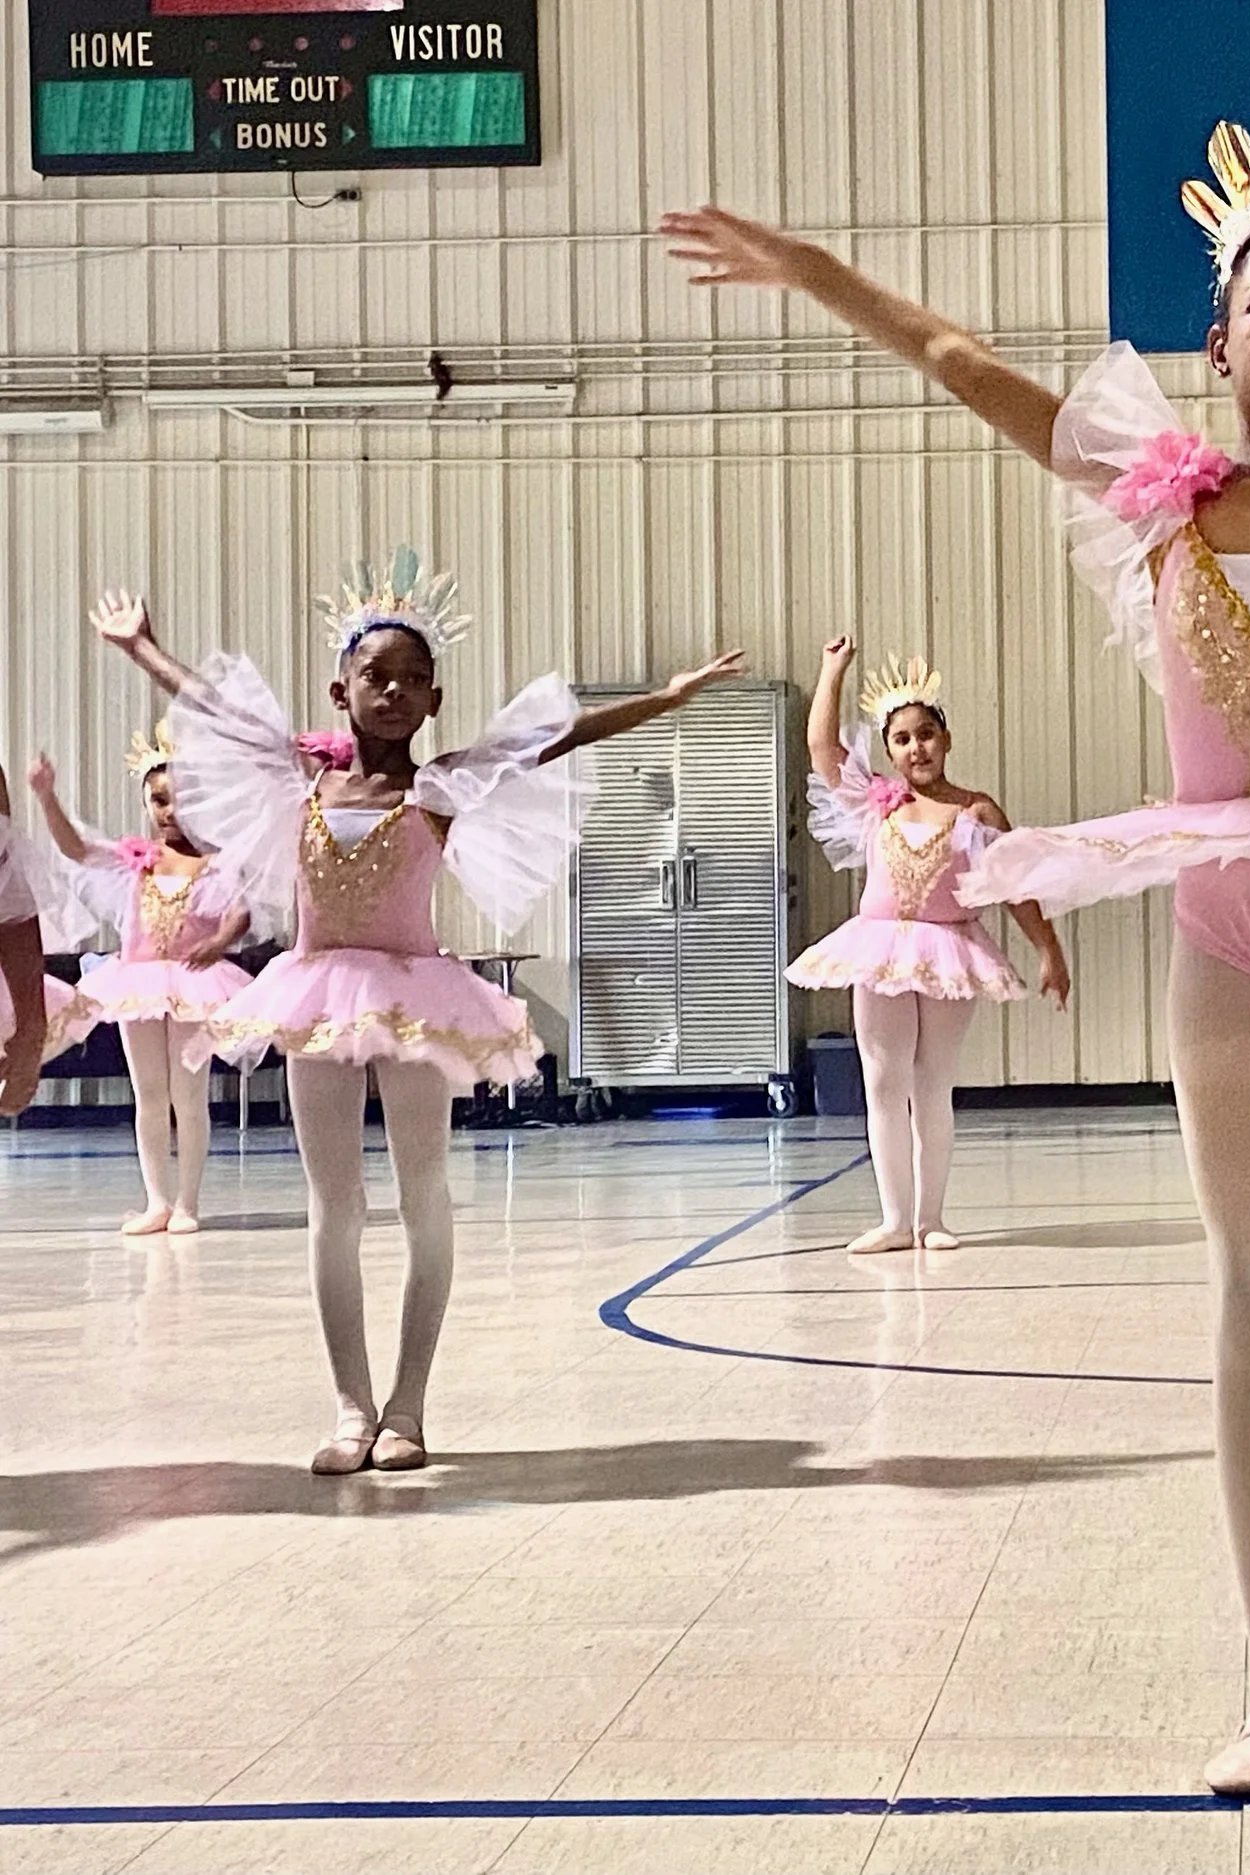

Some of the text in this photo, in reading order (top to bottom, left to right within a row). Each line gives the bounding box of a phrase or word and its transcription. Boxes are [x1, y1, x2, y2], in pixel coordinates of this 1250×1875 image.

[70, 31, 154, 69] HOME
[390, 23, 503, 60] VISITOR
[222, 75, 340, 104] TIME OUT
[236, 122, 327, 149] BONUS
